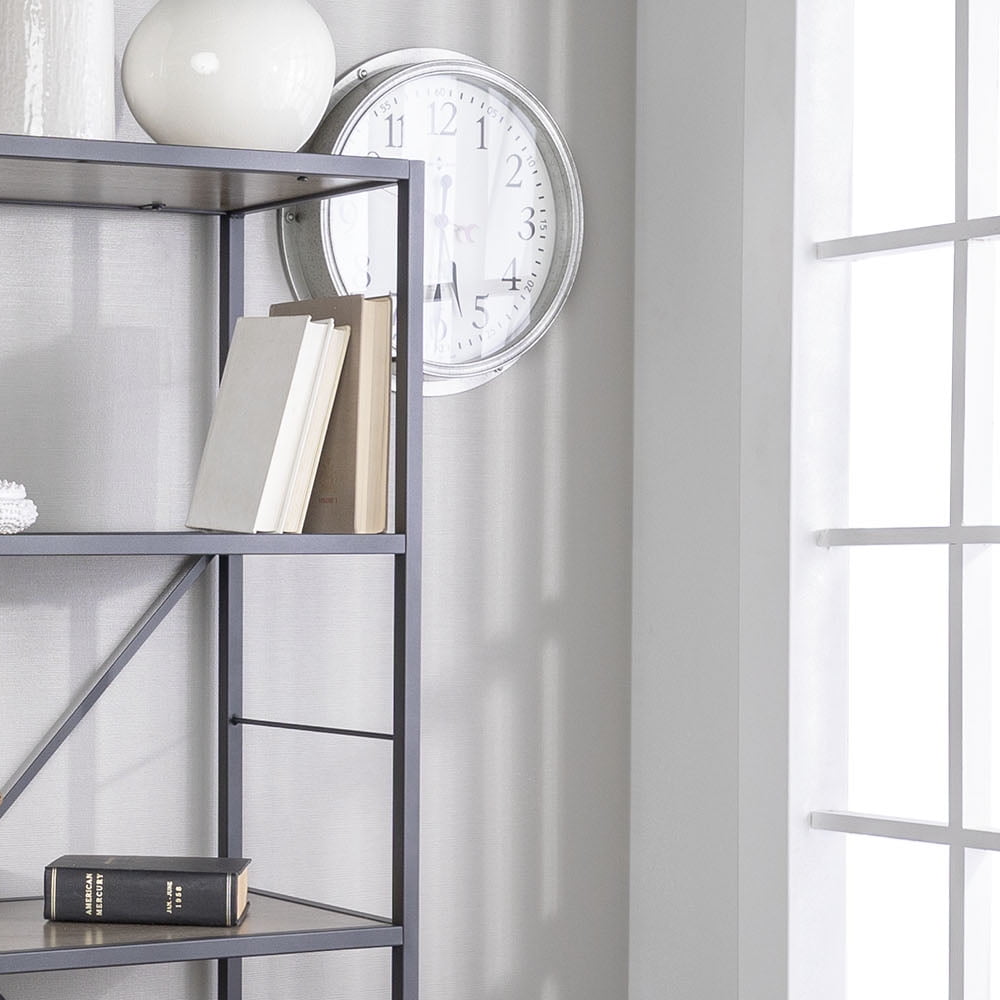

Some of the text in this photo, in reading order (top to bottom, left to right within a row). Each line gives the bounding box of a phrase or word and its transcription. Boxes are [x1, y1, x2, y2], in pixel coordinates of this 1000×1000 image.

[384, 113, 404, 148] 11
[426, 101, 457, 136] 12
[475, 115, 489, 150] 1
[505, 153, 523, 188] 2
[526, 155, 536, 168] 10
[517, 206, 536, 241] 3
[539, 219, 547, 231] 15
[501, 257, 522, 291] 4
[523, 280, 535, 293] 20
[472, 293, 490, 330] 5
[85, 873, 93, 916] AMERICAN
[96, 873, 104, 917] MERCURY
